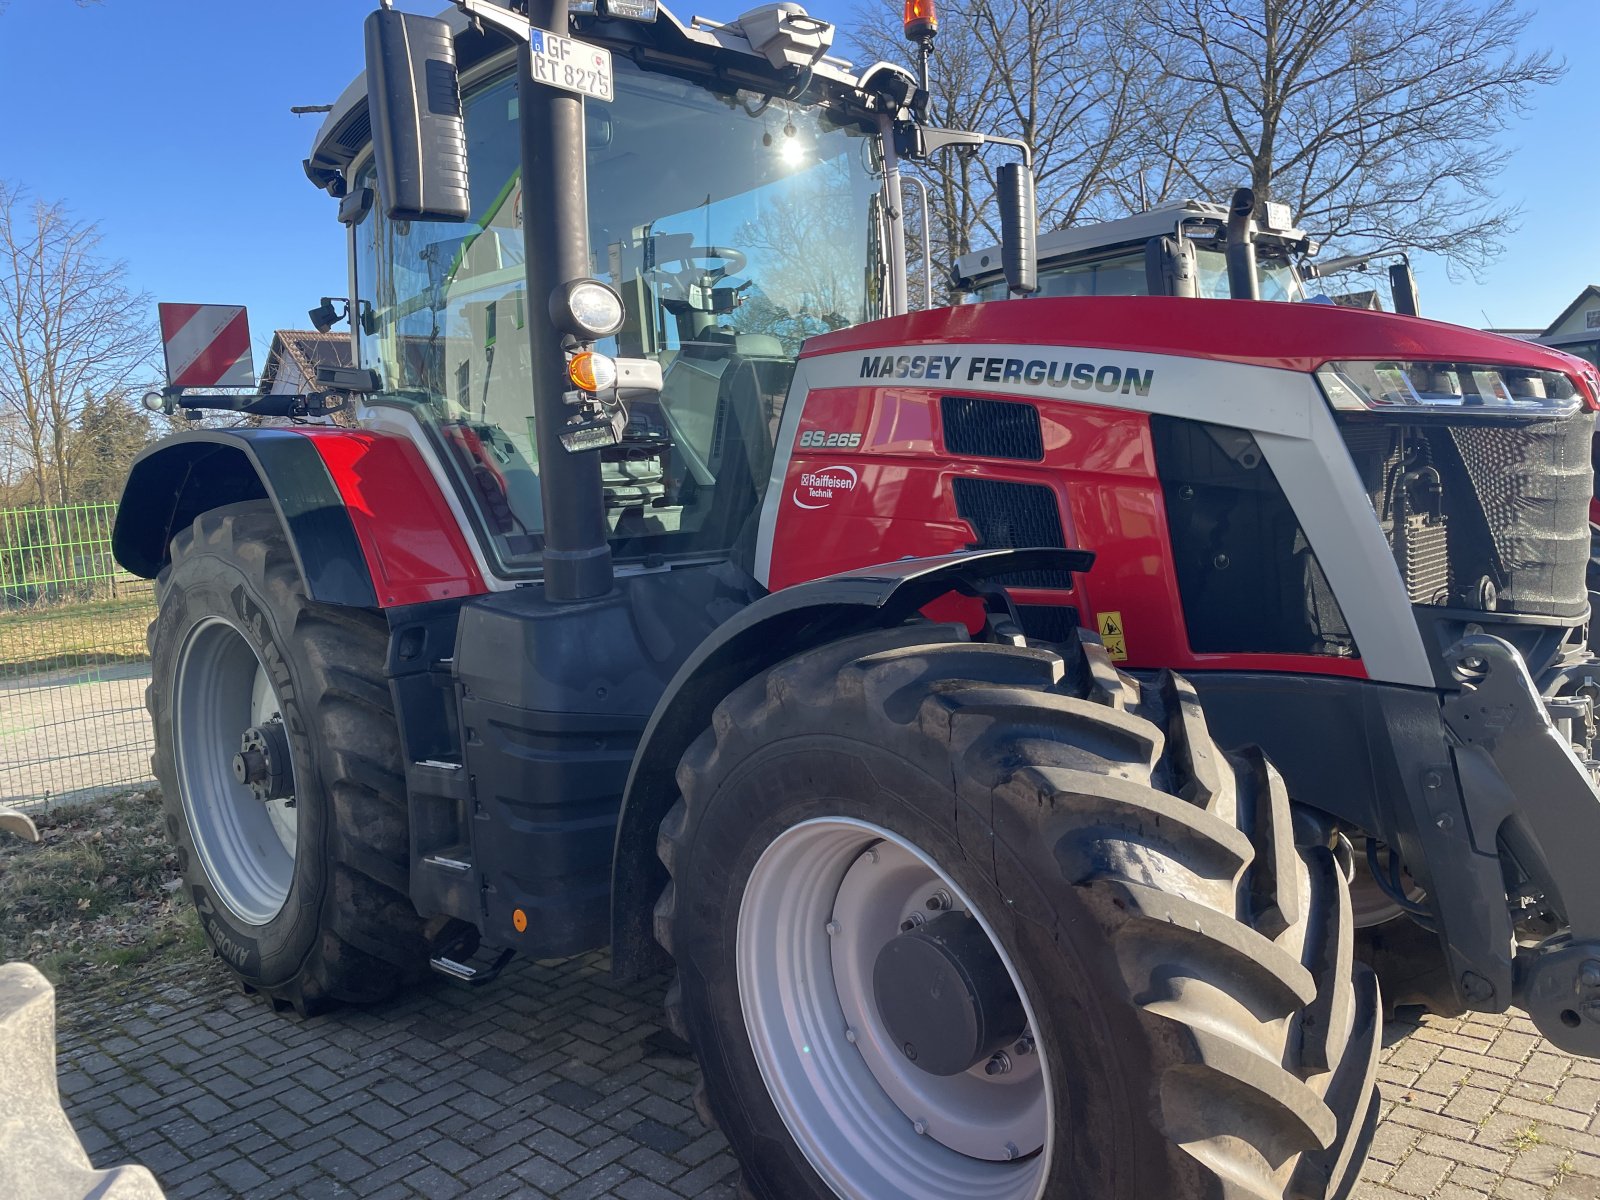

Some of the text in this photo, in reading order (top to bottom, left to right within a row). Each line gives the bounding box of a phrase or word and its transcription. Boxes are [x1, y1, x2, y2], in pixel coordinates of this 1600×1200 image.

[547, 35, 571, 61] GF
[534, 54, 609, 96] RT 8275
[859, 355, 1155, 397] MASSEY FERGUSON
[808, 487, 833, 499] Technik
[809, 474, 852, 489] Raiffeisen
[208, 918, 251, 967] AXIOBIB
